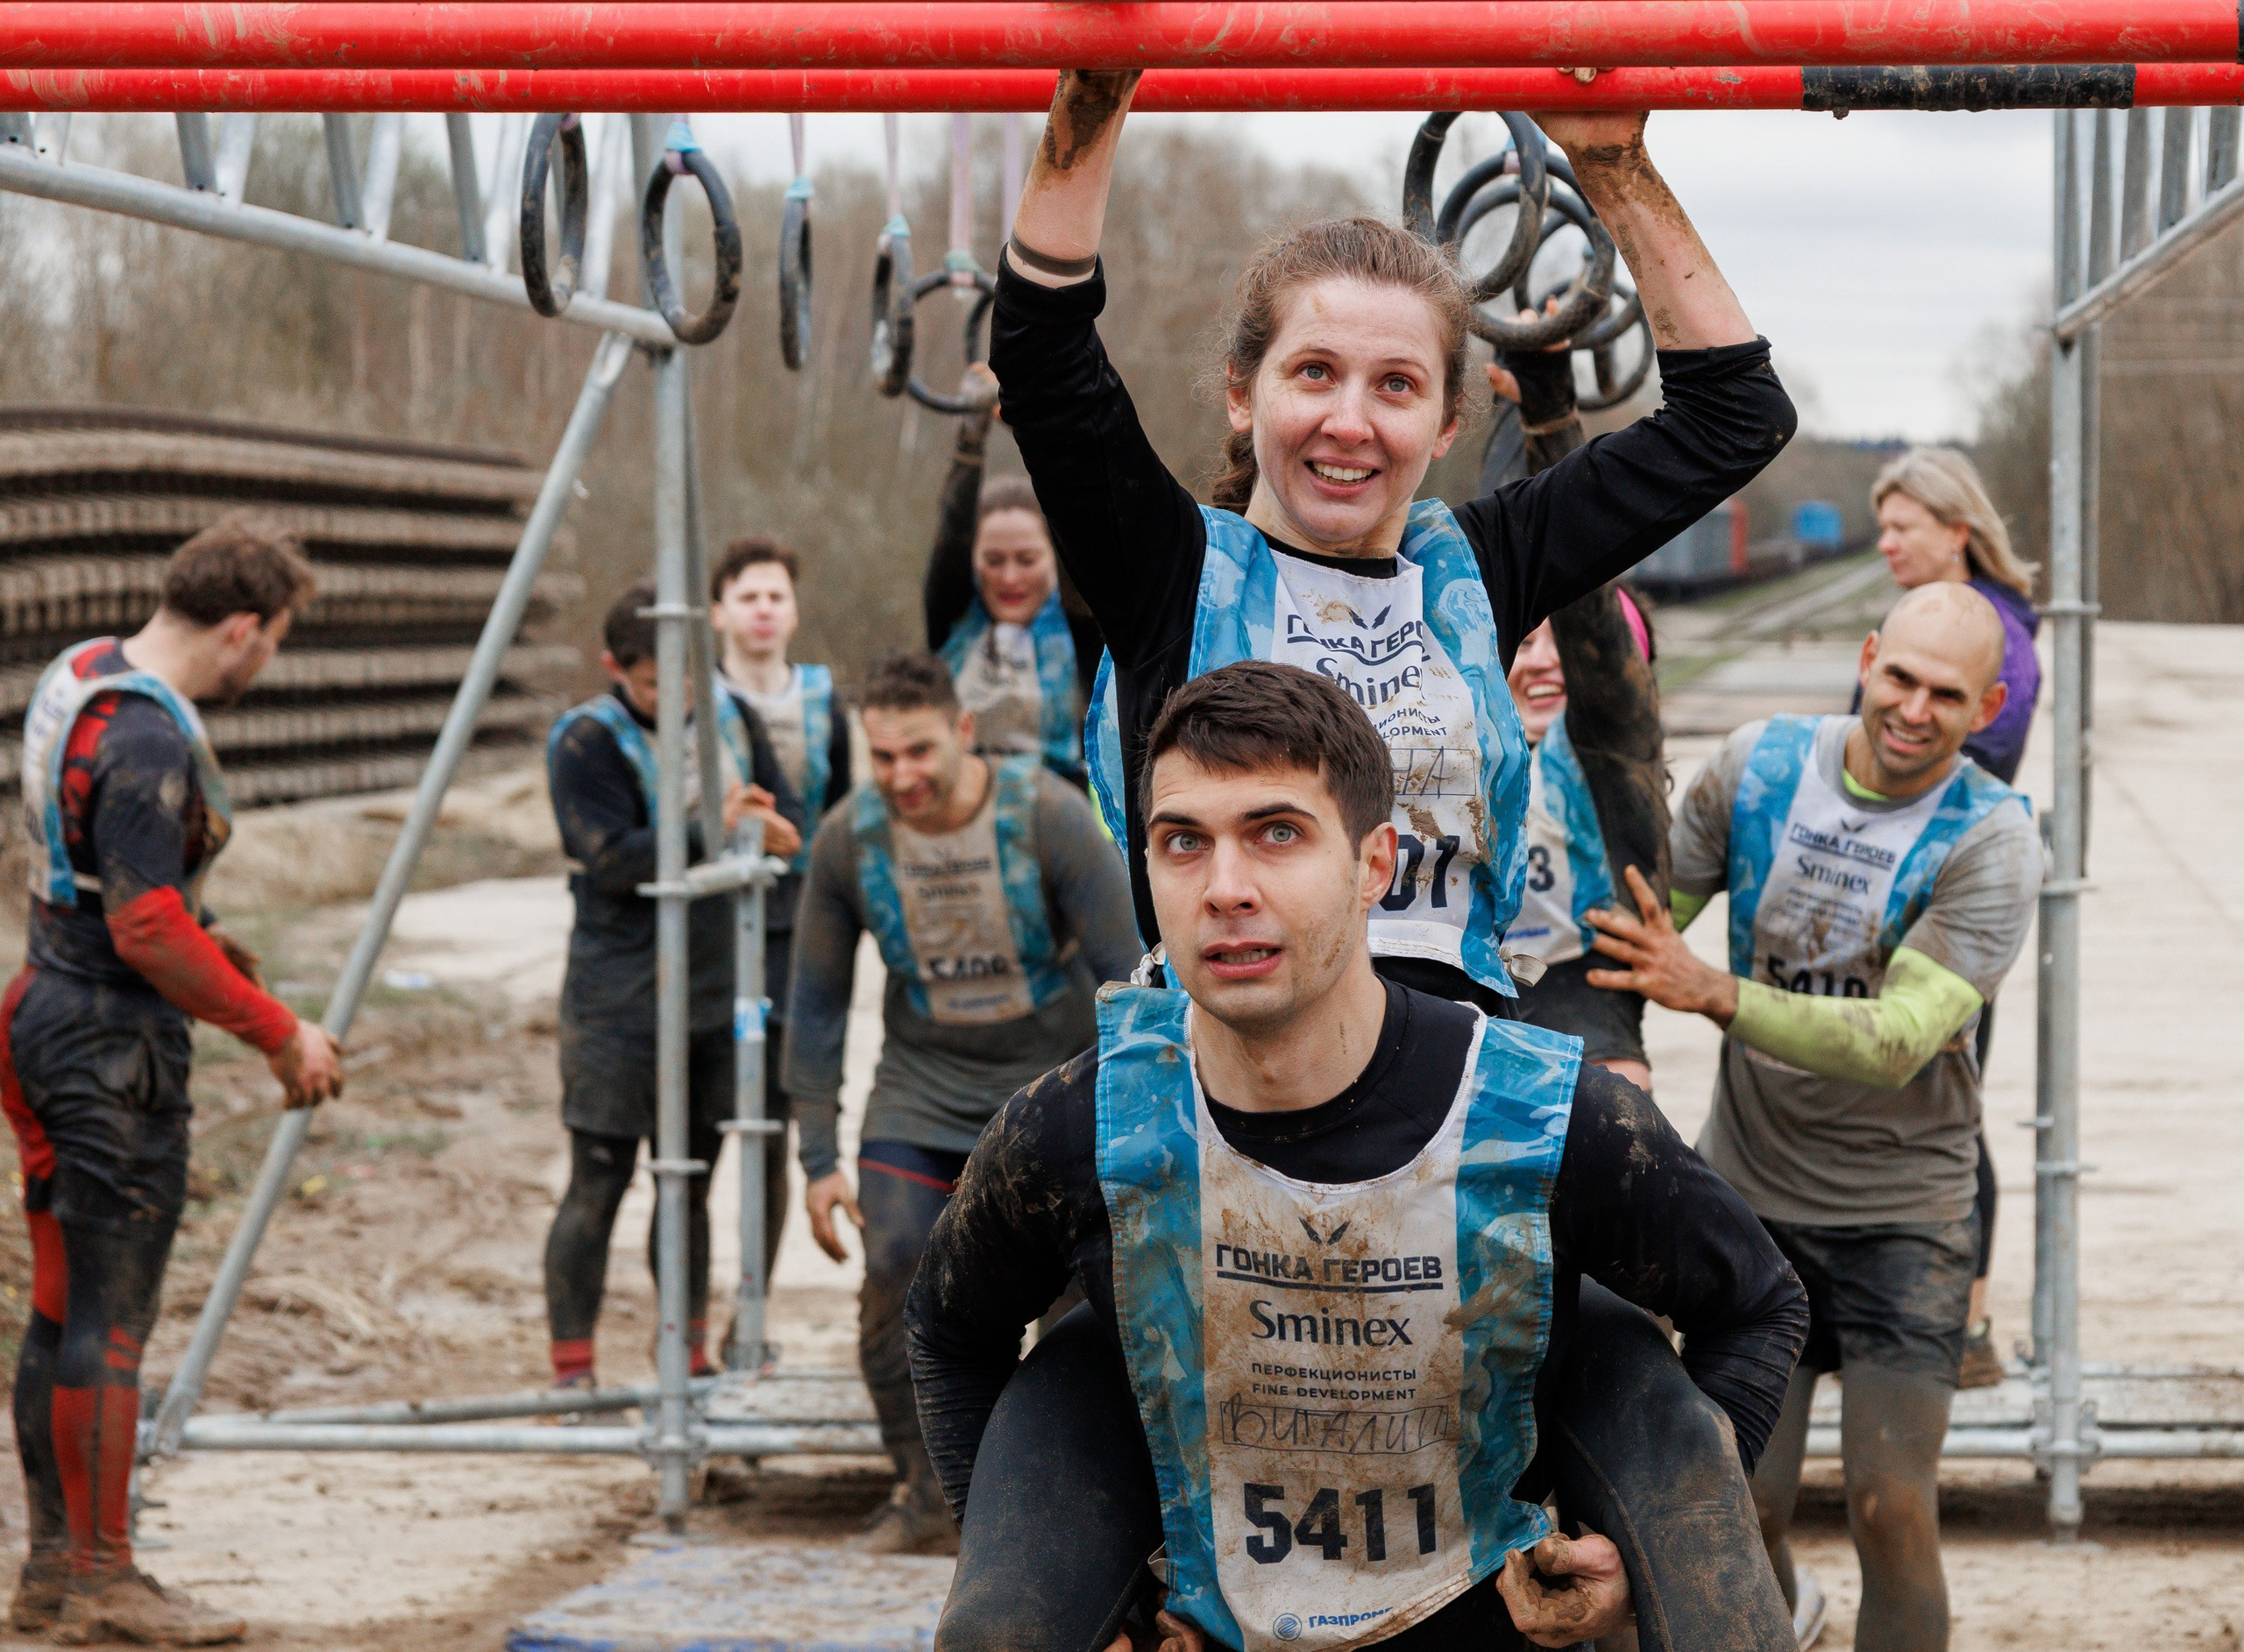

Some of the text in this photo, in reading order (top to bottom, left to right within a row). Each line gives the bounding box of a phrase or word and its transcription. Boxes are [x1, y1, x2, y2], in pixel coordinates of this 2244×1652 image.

[1316, 657, 1425, 705] Smine
[1796, 854, 1870, 895] Sminex
[1216, 1244, 1443, 1283] ГОНКА ГЕРОЕВ
[1249, 1300, 1413, 1346] Sminex
[1252, 1363, 1417, 1381] ПЕРФЕКЦИОНИСТЫ
[1253, 1384, 1417, 1400] FINE DEVELOPMENT
[1243, 1482, 1437, 1564] 5411
